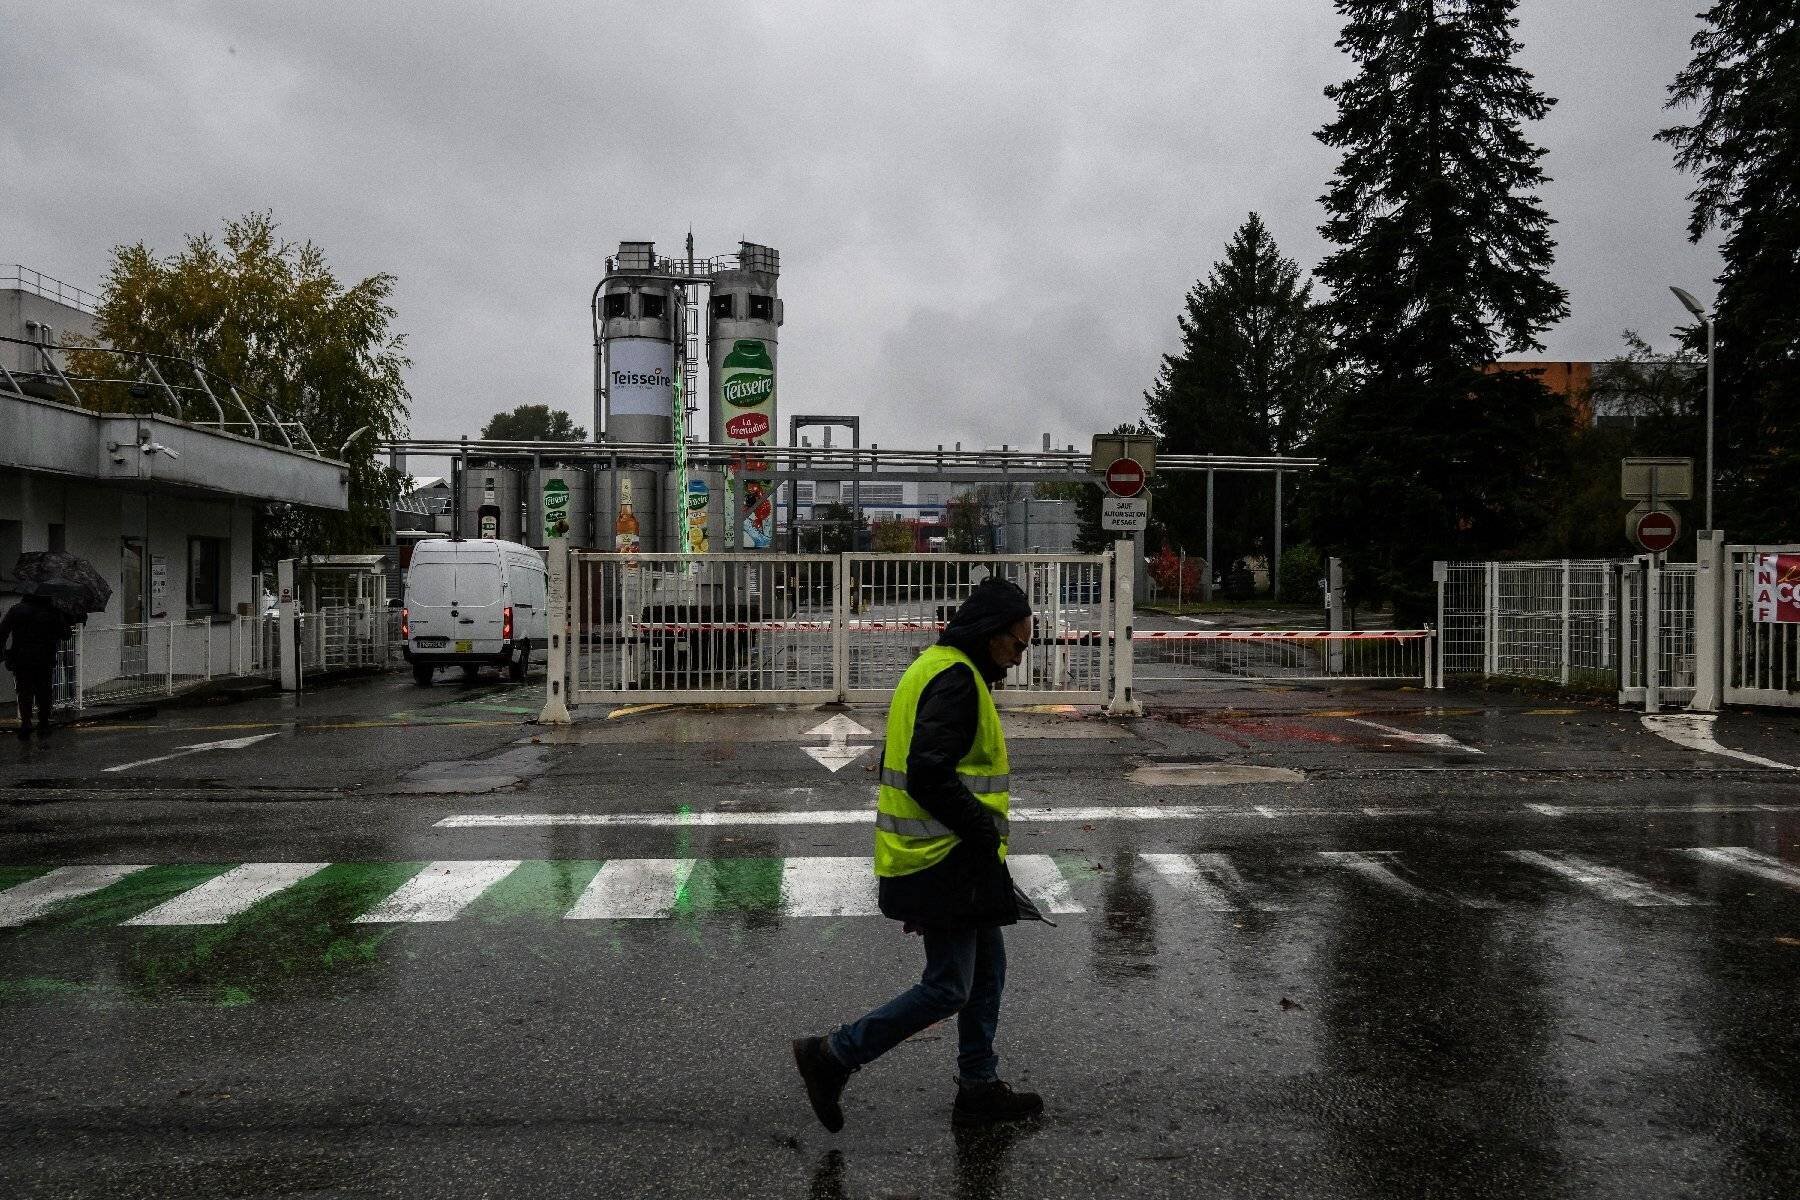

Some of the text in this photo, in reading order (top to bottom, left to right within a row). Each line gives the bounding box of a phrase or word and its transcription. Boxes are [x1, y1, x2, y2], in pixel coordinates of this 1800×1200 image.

[612, 368, 670, 387] Teisseire
[722, 377, 772, 401] Teisseire
[731, 423, 768, 435] Grenadine
